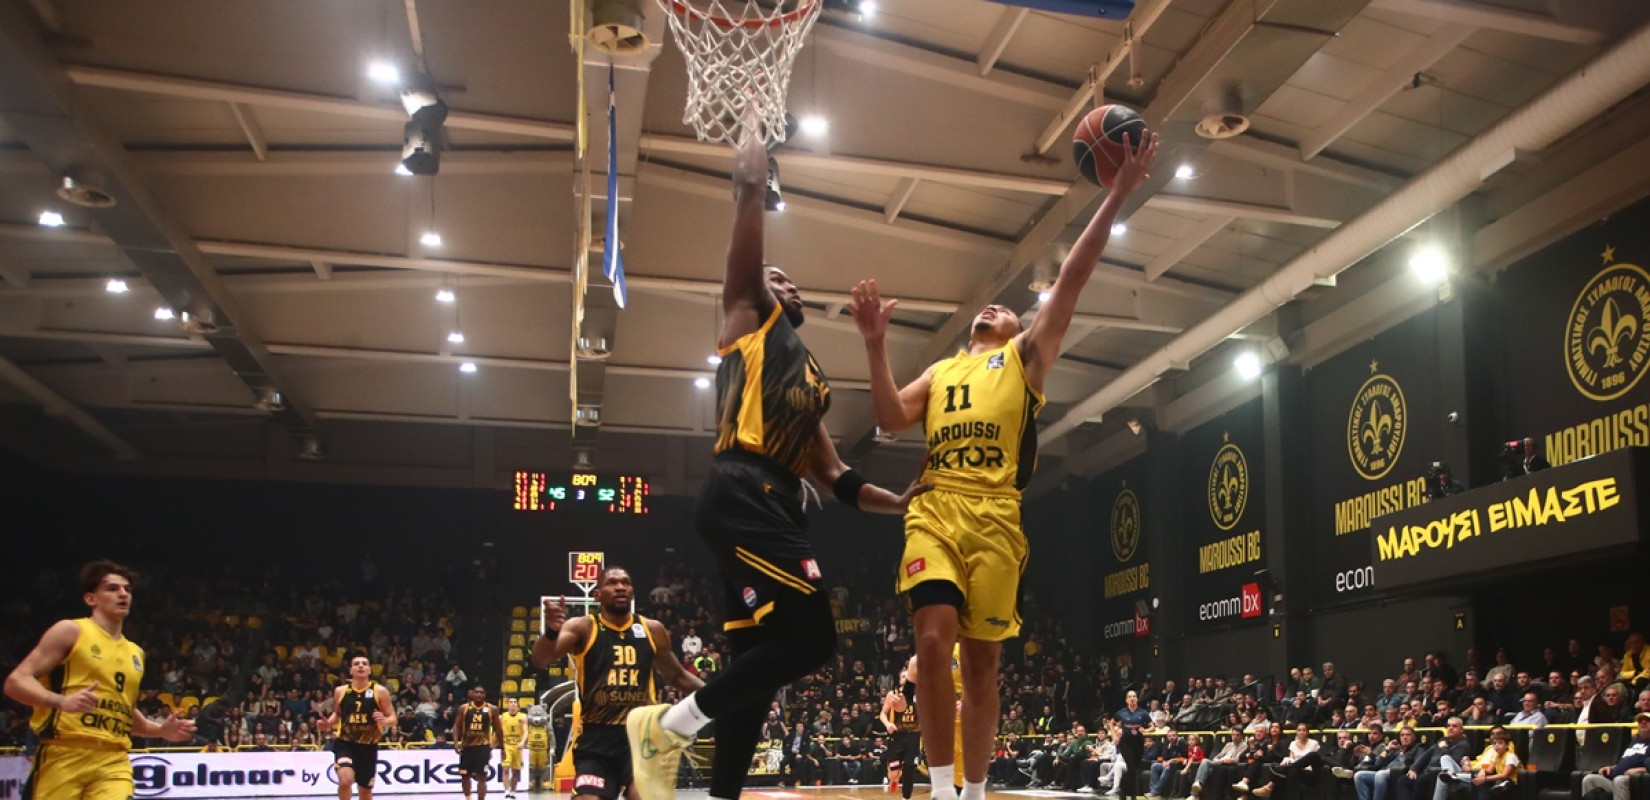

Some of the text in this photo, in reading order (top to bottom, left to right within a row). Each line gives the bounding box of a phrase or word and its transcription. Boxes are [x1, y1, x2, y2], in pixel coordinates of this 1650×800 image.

[1602, 371, 1626, 389] 1896
[944, 383, 972, 413] 11
[1545, 403, 1650, 468] MAROUSS
[598, 488, 616, 501] 52
[1335, 483, 1403, 536] MAROUSSI
[1199, 529, 1261, 574] MAROUSSI BC
[574, 564, 599, 580] 20
[1104, 562, 1150, 599] MAROUSSI BC
[612, 645, 637, 666] 30
[114, 671, 125, 692] 9
[607, 669, 639, 687] AEK
[355, 701, 363, 712] 7
[349, 714, 368, 724] AEK
[133, 762, 295, 790] golmar
[302, 769, 320, 787] by
[576, 774, 605, 789] AVIS
